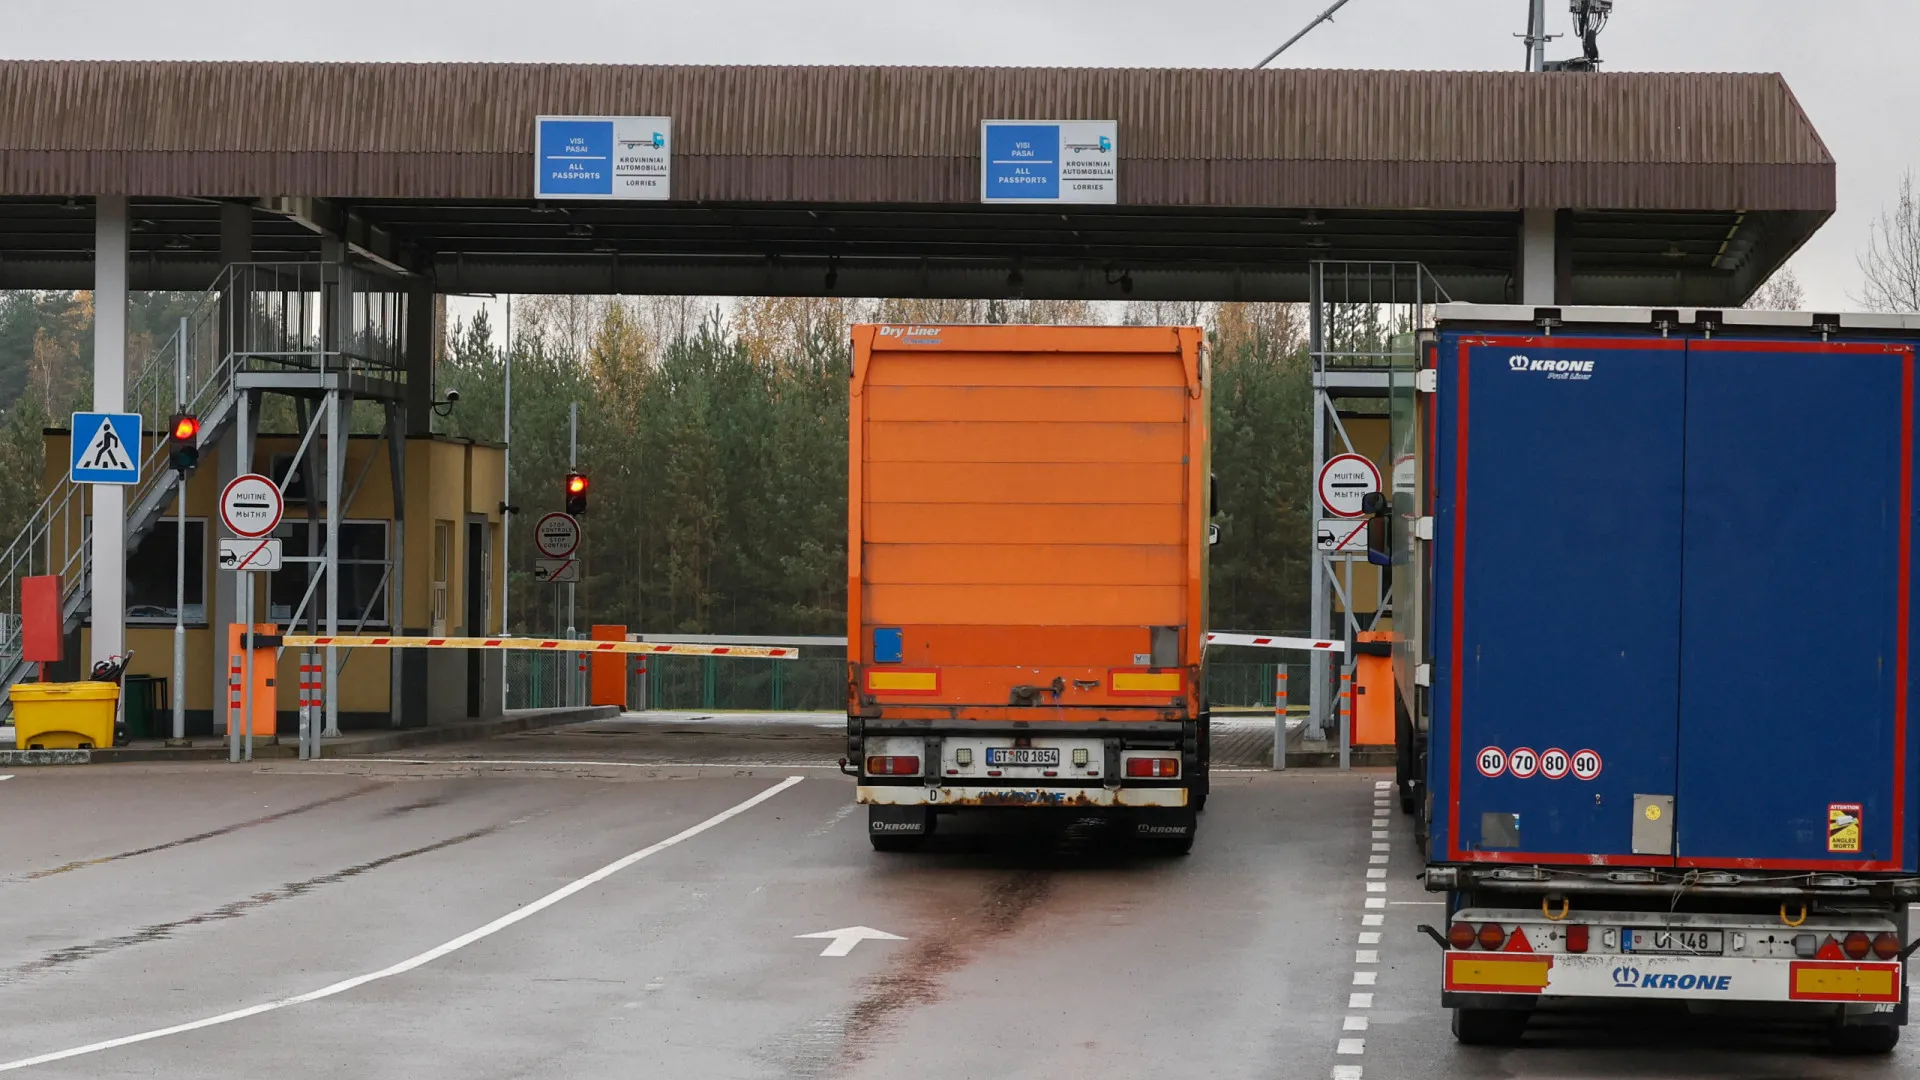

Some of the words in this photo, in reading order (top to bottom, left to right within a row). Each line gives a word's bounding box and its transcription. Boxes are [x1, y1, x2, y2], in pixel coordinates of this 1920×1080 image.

[565, 145, 588, 153] PASAI
[880, 326, 904, 338] Dry
[906, 325, 941, 336] Liner
[1530, 360, 1595, 371] KRONE
[994, 750, 1008, 762] GT
[1015, 751, 1029, 762] RQ
[1031, 751, 1057, 762] 1854
[1482, 754, 1501, 769] 60
[1515, 755, 1533, 770] 70
[1545, 756, 1564, 771] 80
[1576, 757, 1595, 772] 90
[930, 790, 937, 801] D
[1149, 826, 1188, 834] KRONE
[1680, 932, 1708, 949] 148
[1641, 973, 1733, 991] KRONE
